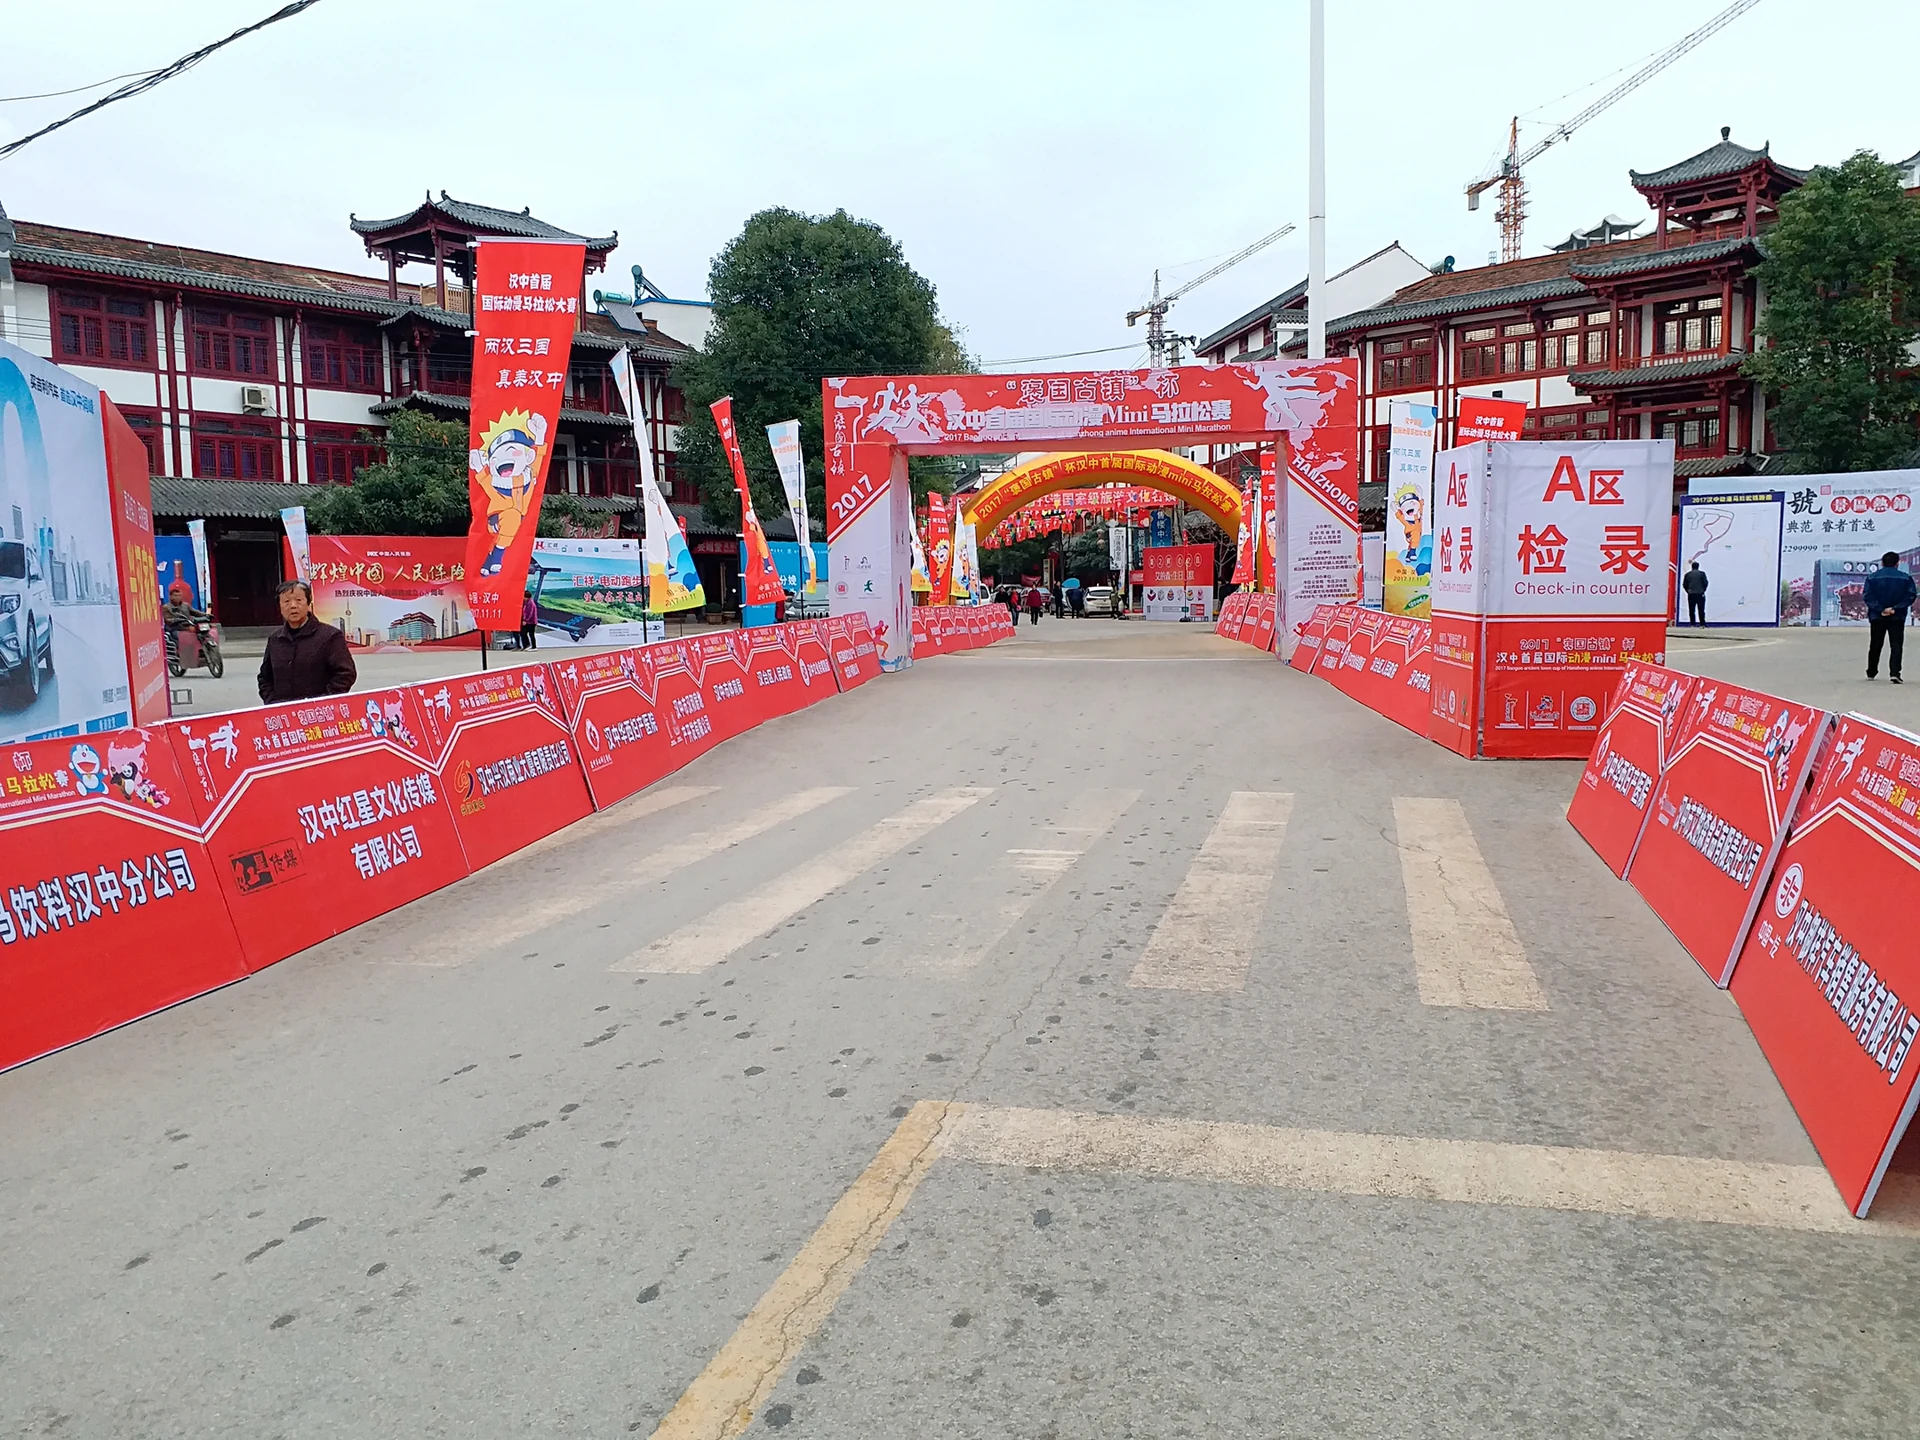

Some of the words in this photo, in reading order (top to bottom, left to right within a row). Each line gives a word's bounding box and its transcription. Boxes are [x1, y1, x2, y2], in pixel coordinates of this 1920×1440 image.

[508, 273, 552, 291] 汉中首届
[481, 294, 578, 314] 国际动漫马拉松大赛
[484, 337, 551, 356] 两汉三国
[495, 368, 564, 391] 真美汉中
[1156, 374, 1181, 399] 杯
[946, 404, 1103, 431] 汉中首届国际动漫
[1104, 403, 1148, 424] Mini
[1151, 400, 1231, 423] 马拉松赛
[1475, 415, 1505, 427] 汉中首届
[1105, 428, 1128, 437] anime
[1129, 425, 1176, 435] International
[1178, 424, 1194, 433] Mini
[1195, 423, 1231, 433] Marathon
[1292, 455, 1358, 513] HANZHONG
[1445, 461, 1468, 507] A区
[1542, 455, 1625, 505] A区
[831, 473, 874, 520] 2017
[1440, 525, 1474, 575] 检录
[1517, 524, 1651, 576] 检录
[392, 562, 466, 585] 人民保险
[1514, 581, 1585, 595] Check-in
[1590, 582, 1651, 595] counter
[1520, 638, 1549, 651] 2017
[1496, 651, 1591, 664] 汉中首届国际动漫
[1592, 653, 1617, 664] mini
[253, 725, 322, 752] 汉中首届国际动漫
[322, 724, 339, 739] mini
[6, 769, 69, 795] 马拉松赛
[32, 794, 47, 803] Mini
[47, 790, 76, 800] Marathon
[297, 771, 438, 845] 汉中红星文化传媒
[351, 824, 423, 880] 有限公司
